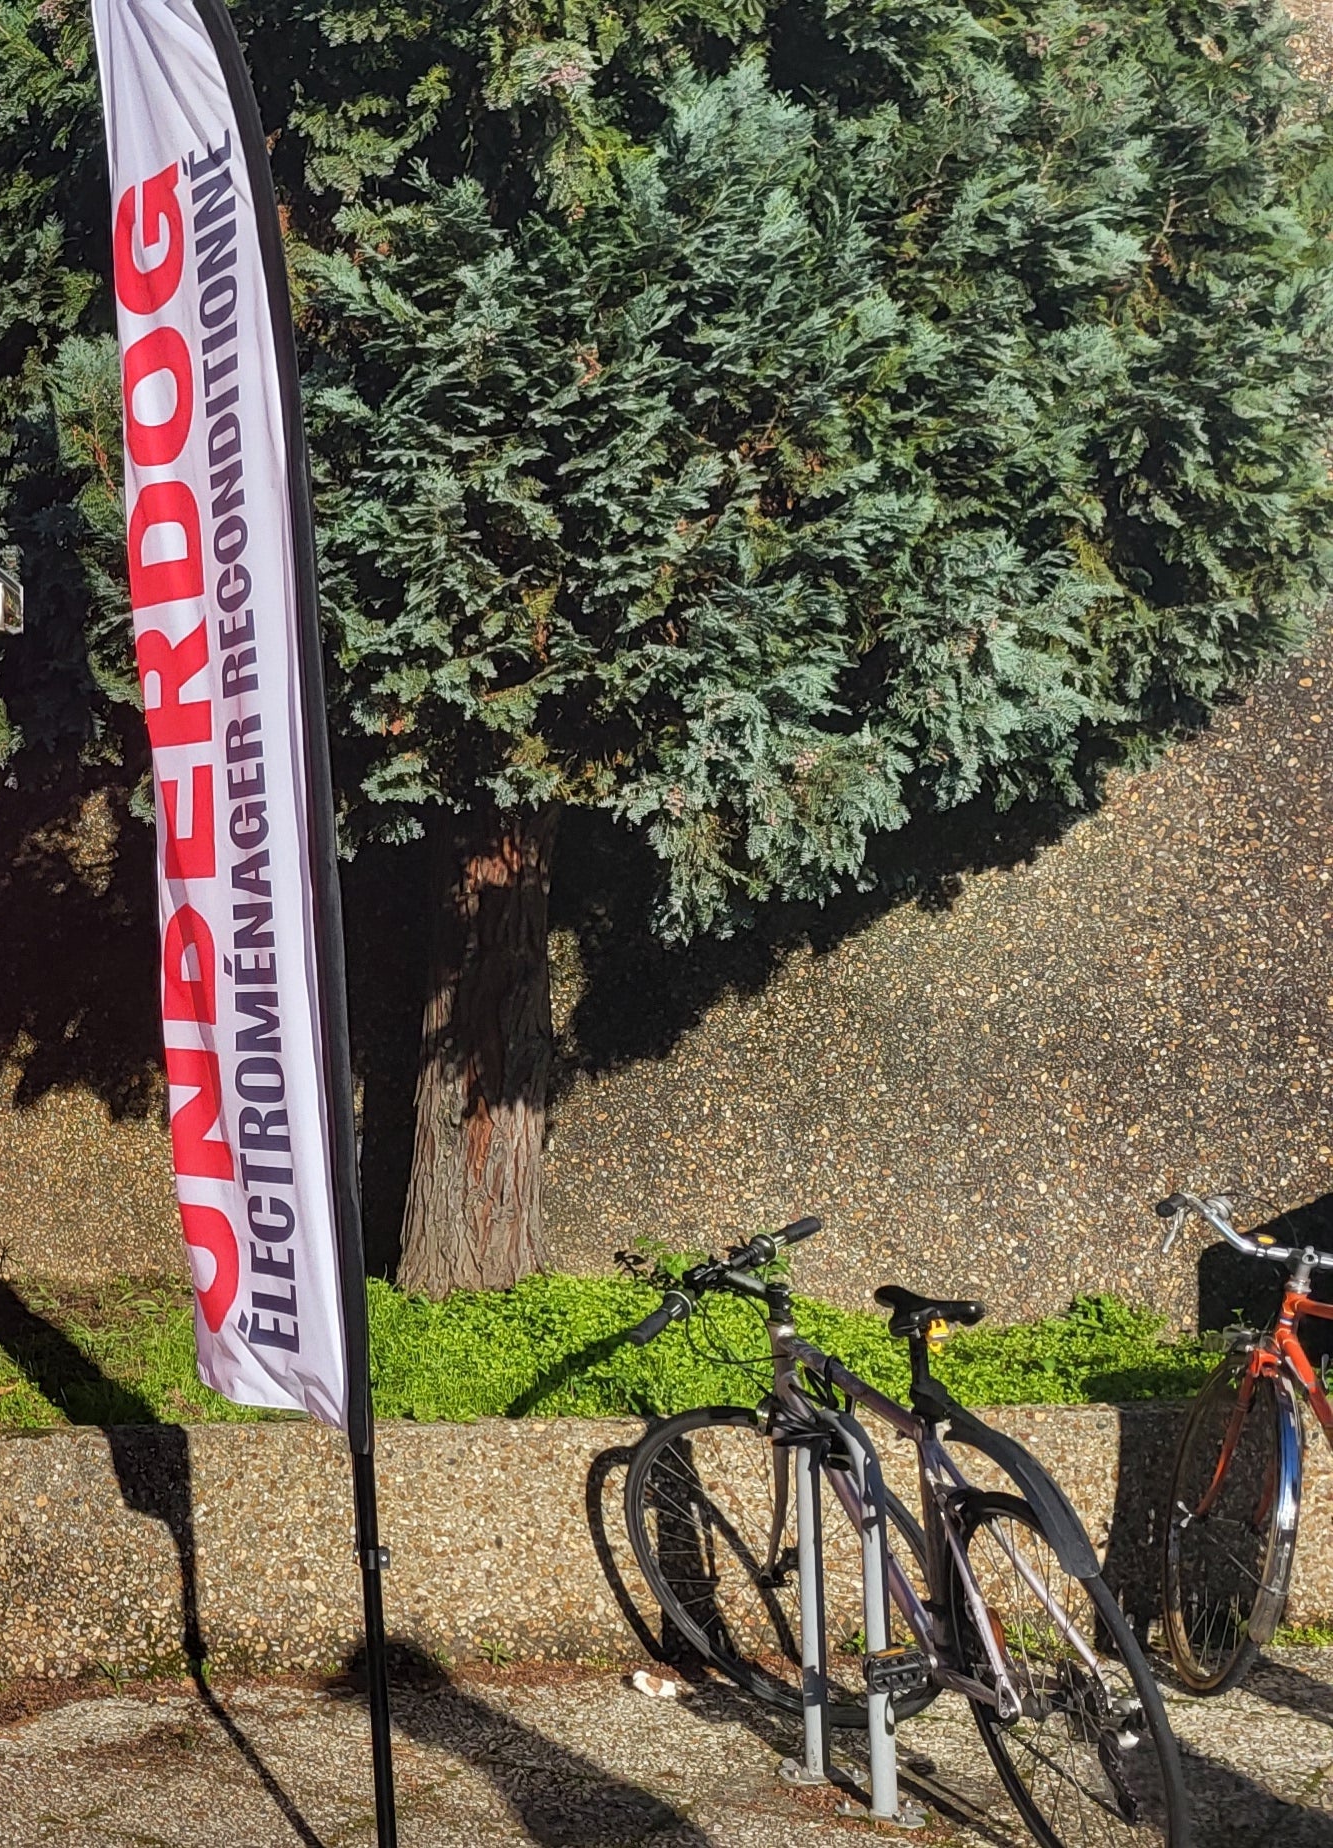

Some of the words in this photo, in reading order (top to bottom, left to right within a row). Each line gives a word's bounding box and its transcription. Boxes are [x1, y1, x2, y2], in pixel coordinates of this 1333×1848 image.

[181, 128, 259, 699] RECONDITIONNÉ
[114, 161, 239, 1334] UNDERDOG
[223, 711, 301, 1355] ÉLECTROMÉNAGER
